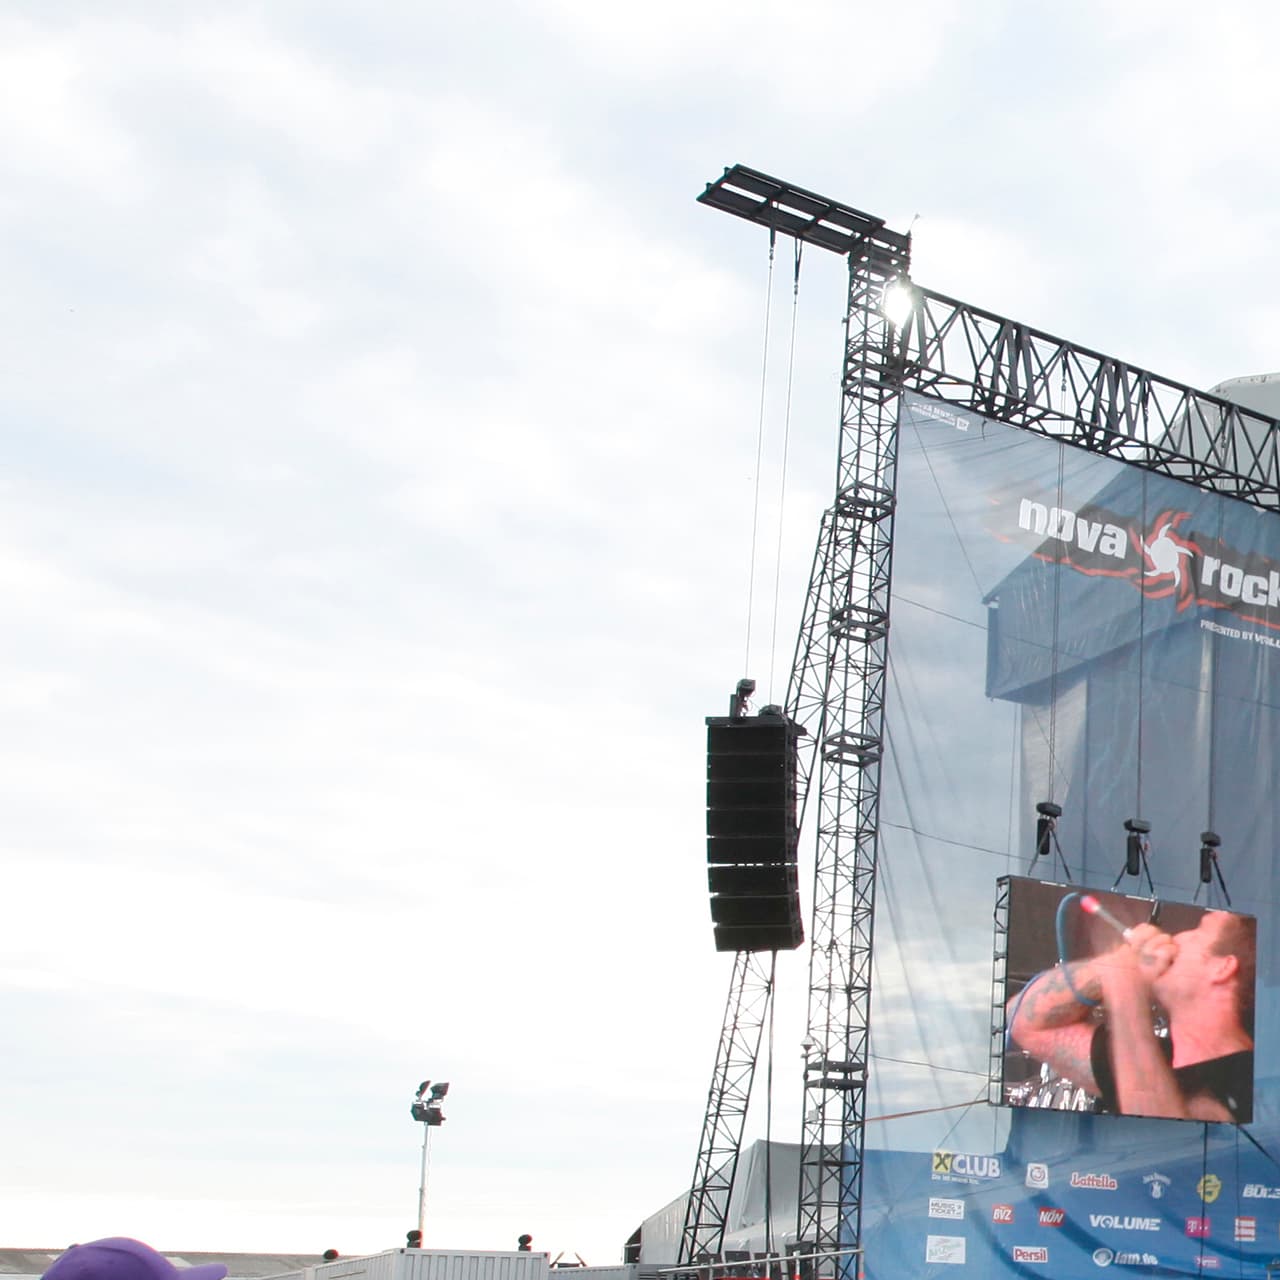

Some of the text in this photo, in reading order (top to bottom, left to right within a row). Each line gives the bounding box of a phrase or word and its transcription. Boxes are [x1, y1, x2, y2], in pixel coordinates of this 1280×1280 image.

[1018, 498, 1128, 560] nova
[1242, 631, 1254, 641] BY
[1072, 1173, 1116, 1189] Lattella
[993, 1209, 1012, 1220] BVZ
[1089, 1214, 1161, 1231] VOLUME
[1014, 1249, 1046, 1261] Persil
